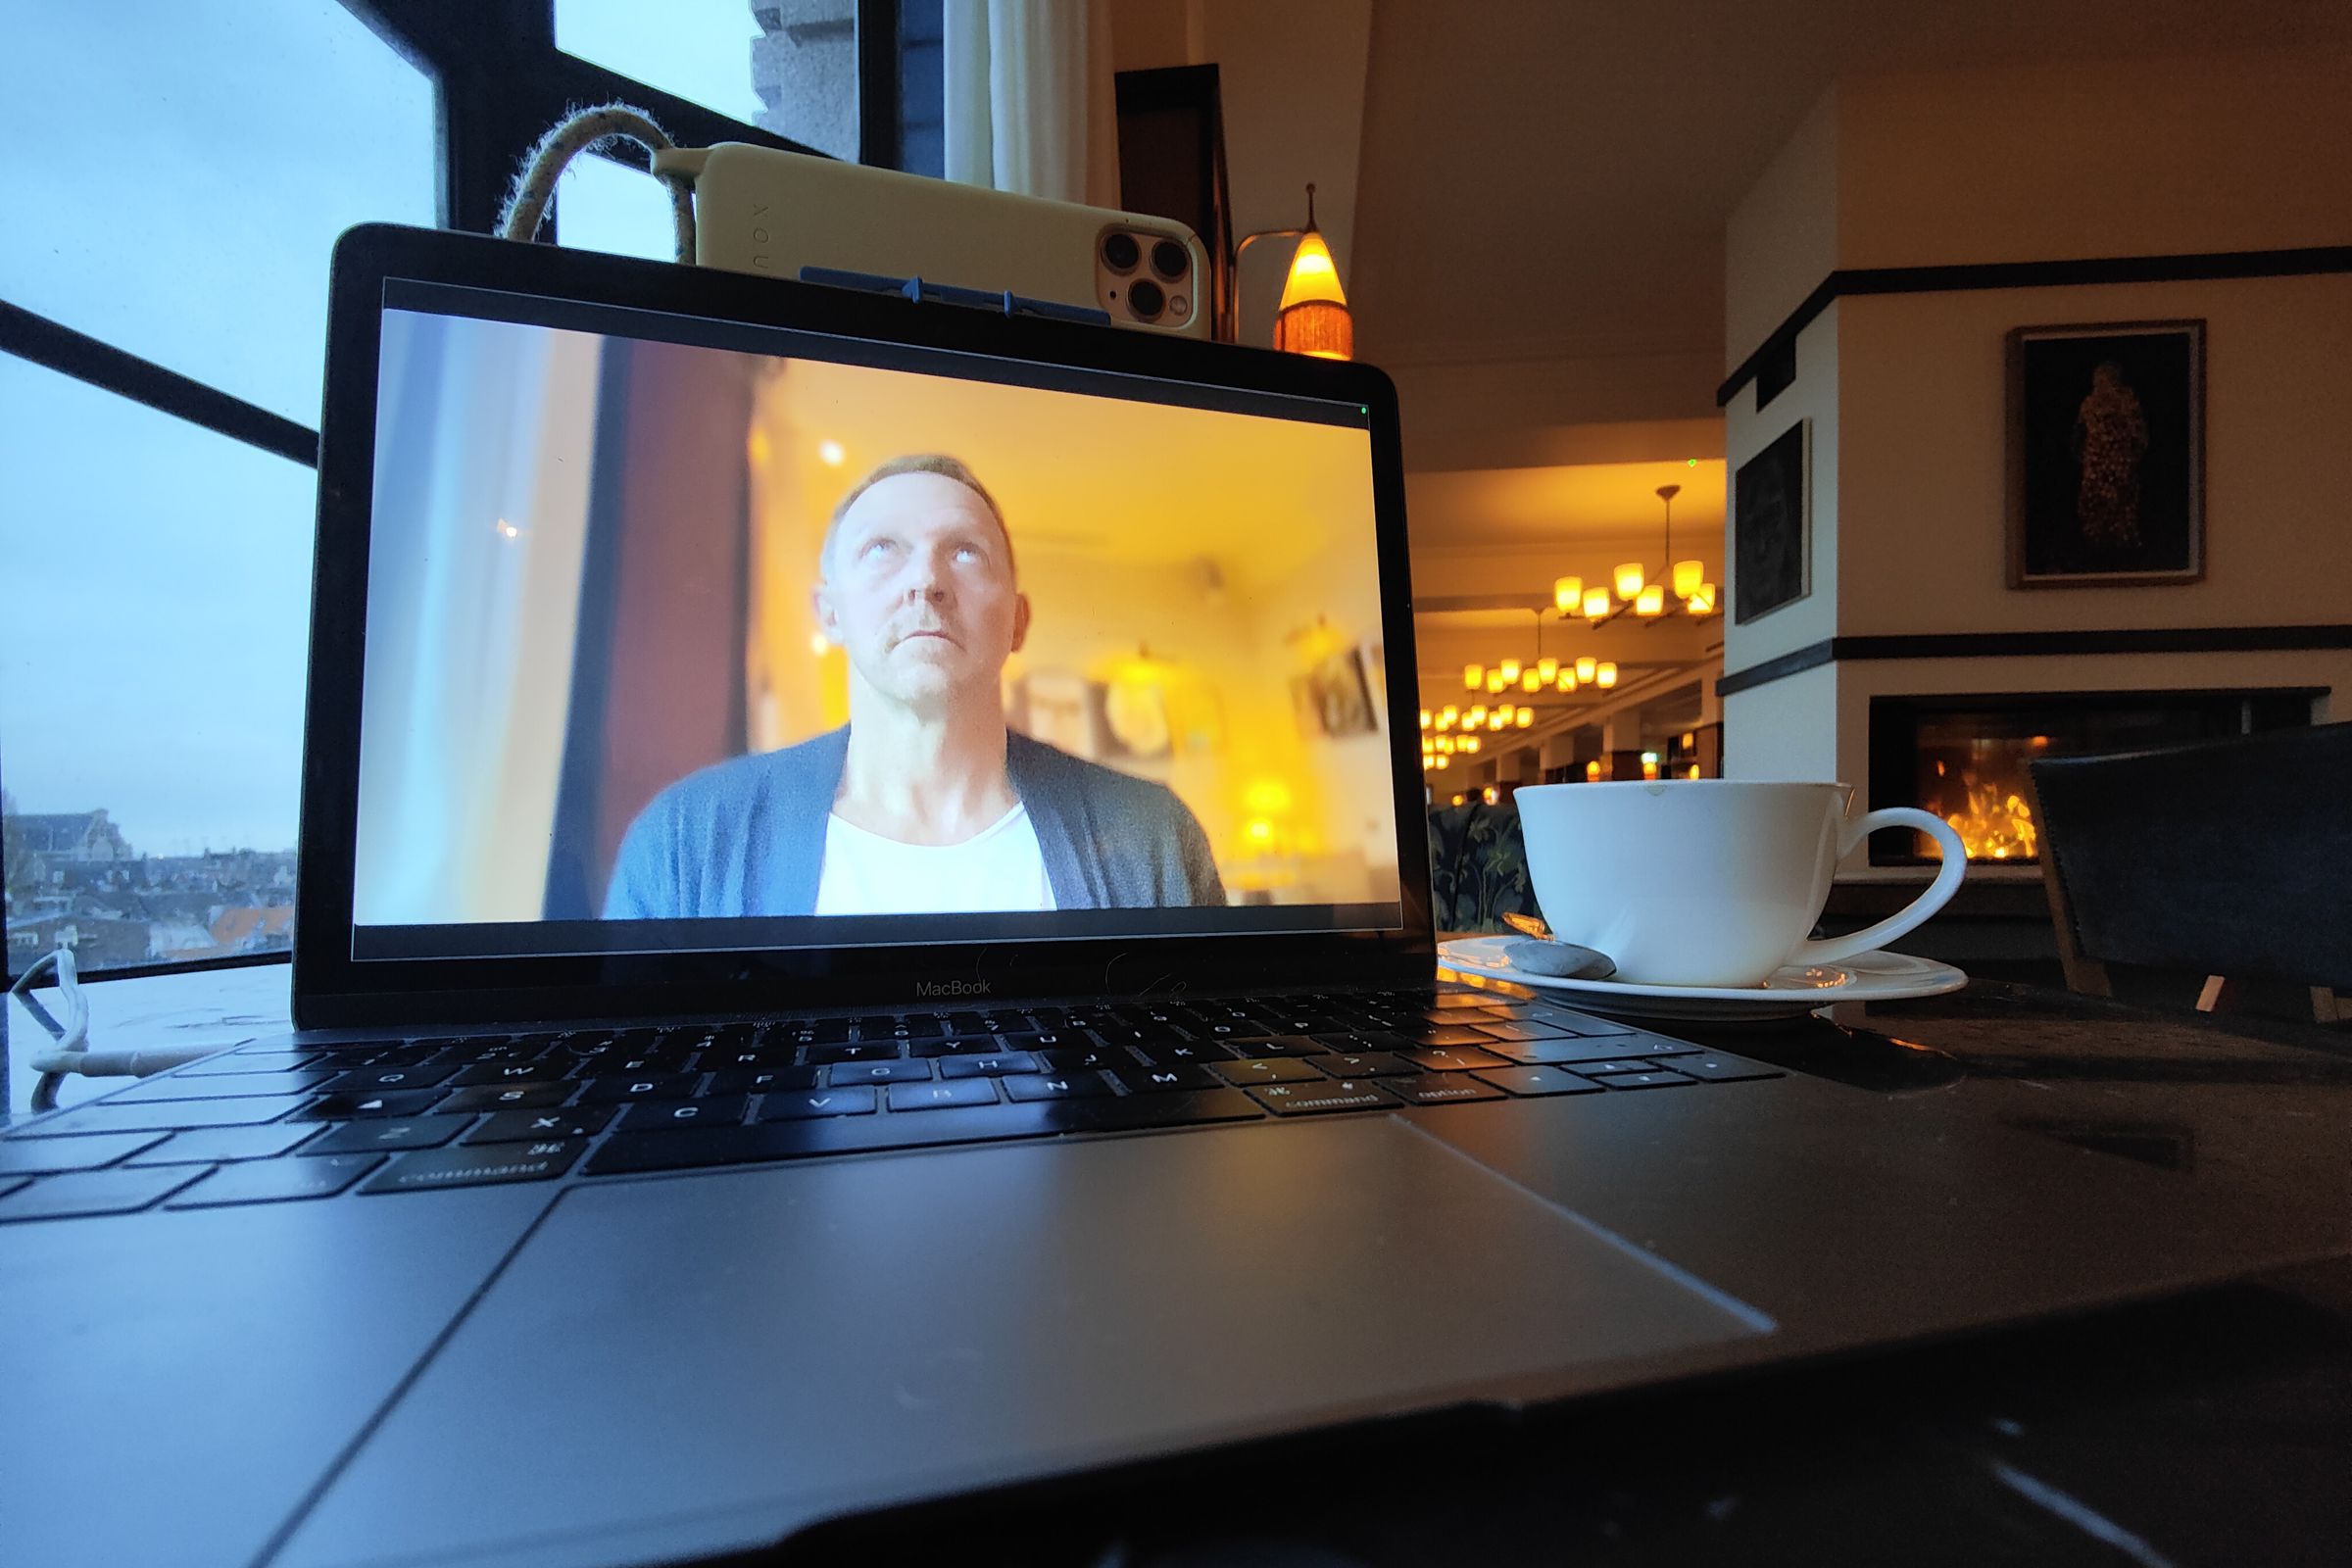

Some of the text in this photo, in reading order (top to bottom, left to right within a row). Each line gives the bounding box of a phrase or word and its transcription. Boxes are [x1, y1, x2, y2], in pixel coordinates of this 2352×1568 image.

[916, 980, 992, 997] MacBook
[504, 1066, 534, 1076] W
[756, 1075, 773, 1084] F
[1152, 1073, 1178, 1082] M
[630, 1083, 654, 1093] D
[1046, 1081, 1068, 1091] N
[499, 1091, 524, 1101] S
[1417, 1088, 1478, 1101] option
[808, 1097, 832, 1107] V
[1285, 1093, 1380, 1108] command
[673, 1106, 699, 1118] C
[530, 1117, 561, 1128] X
